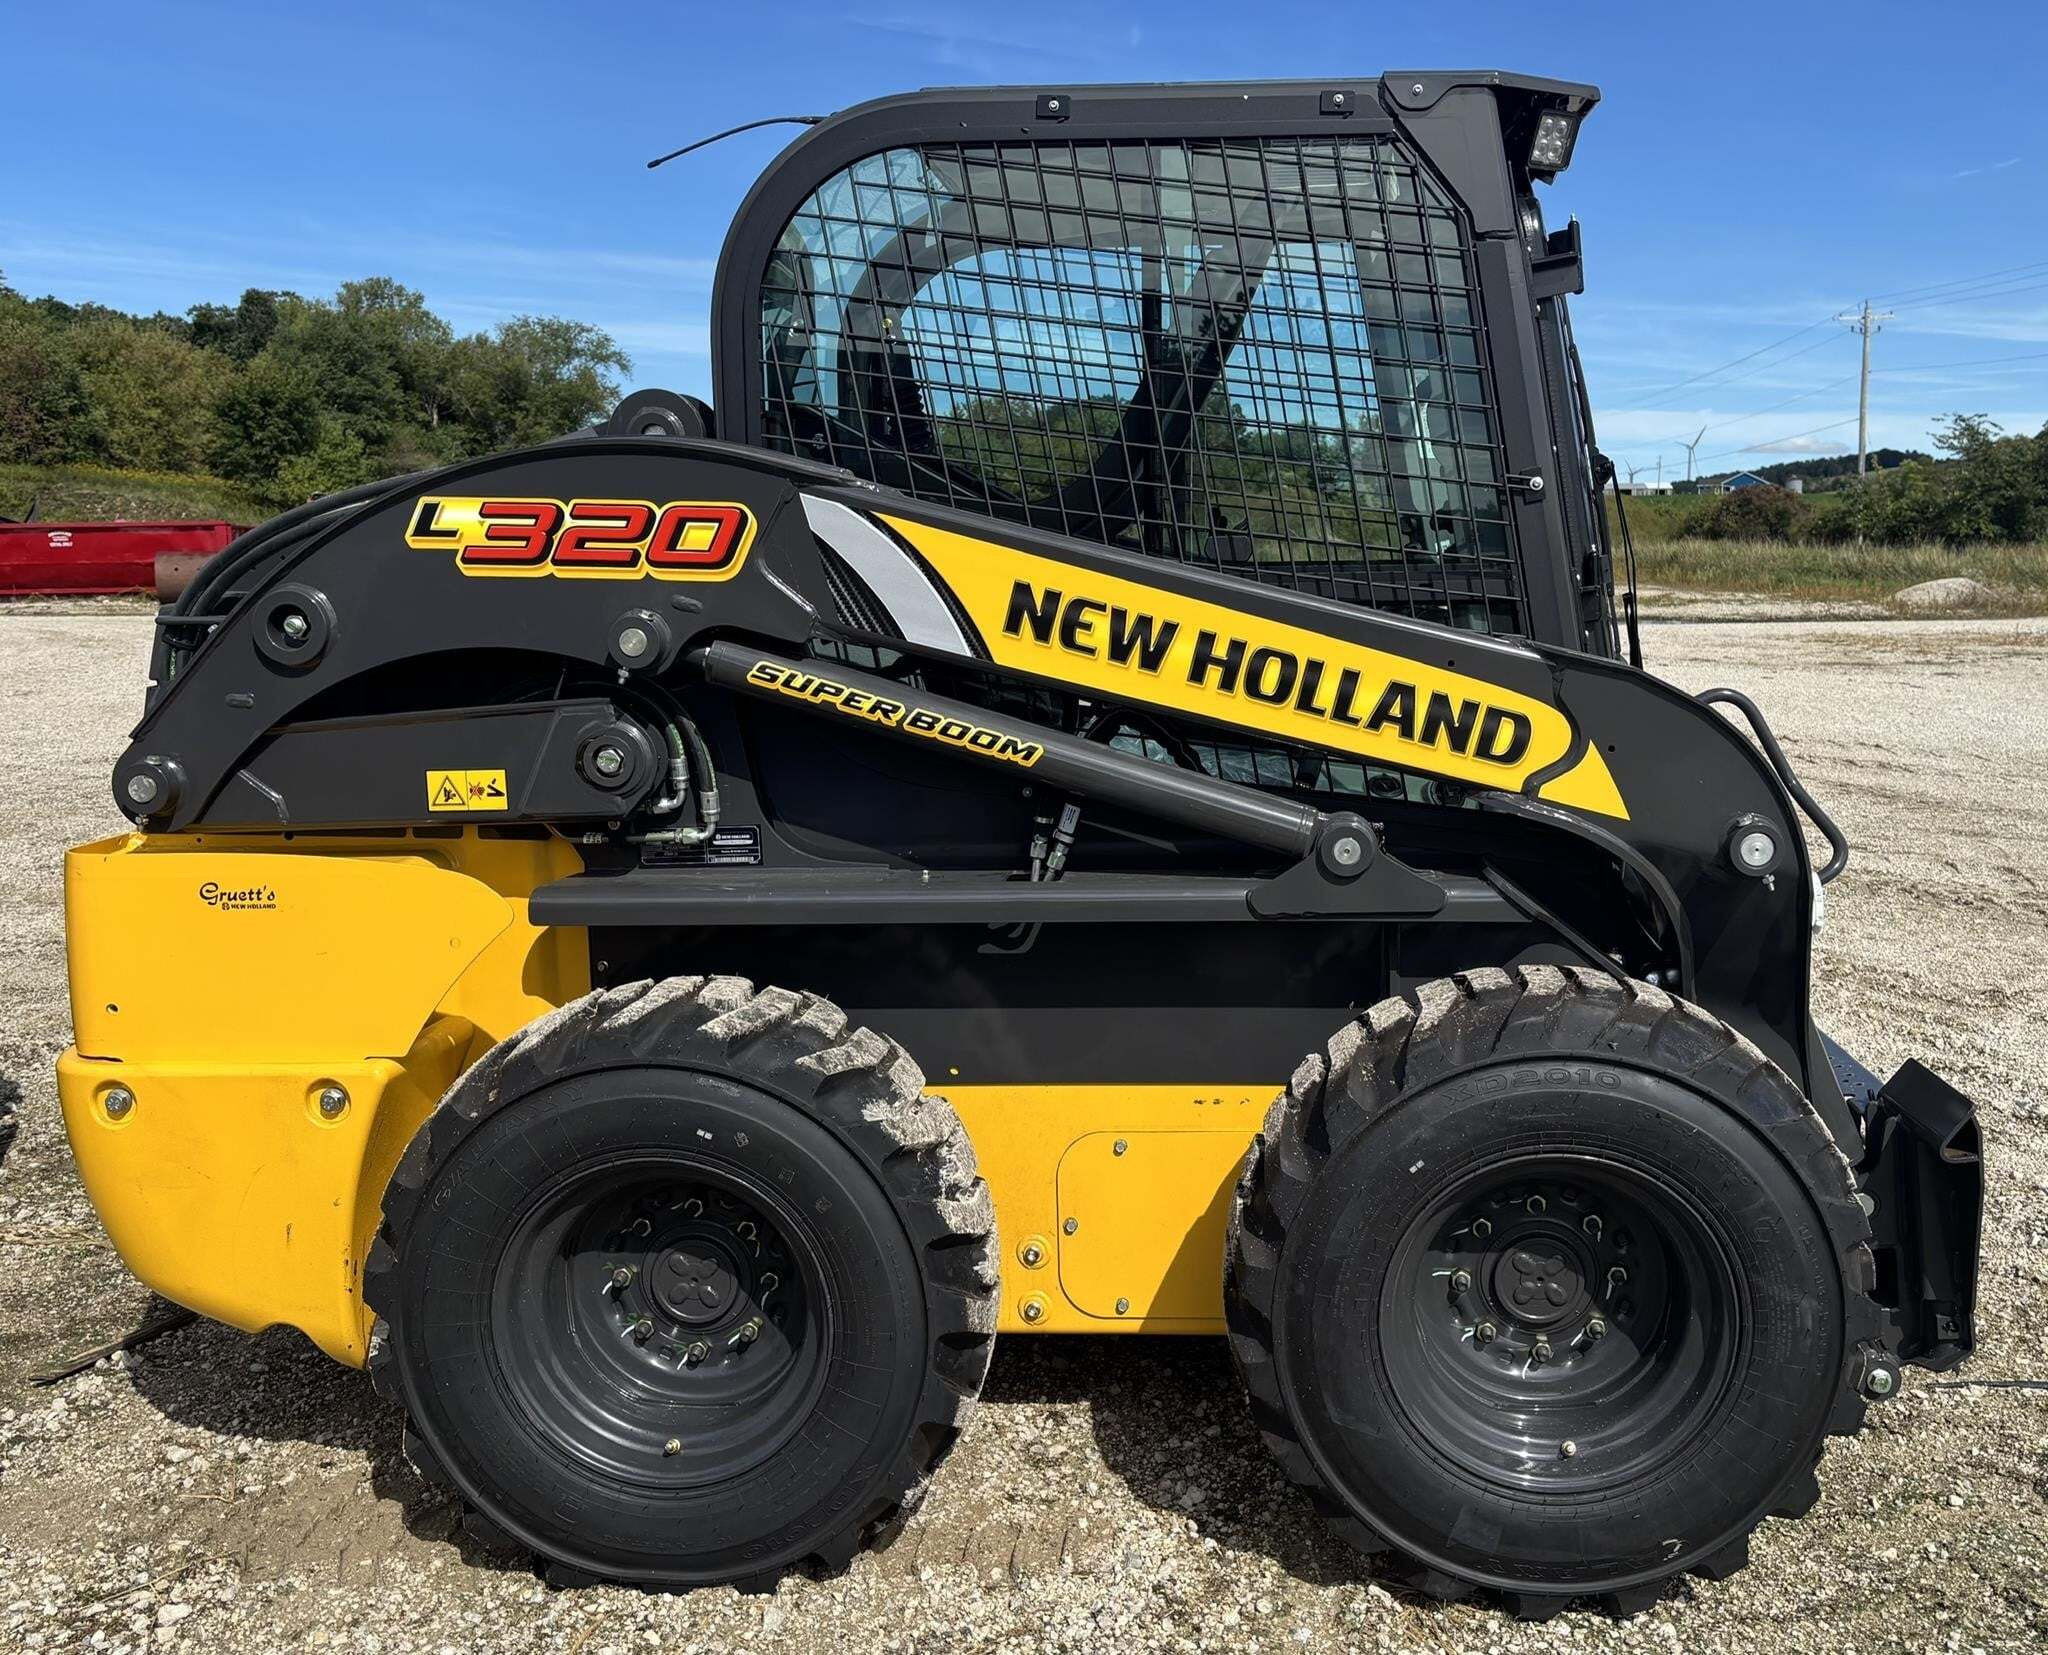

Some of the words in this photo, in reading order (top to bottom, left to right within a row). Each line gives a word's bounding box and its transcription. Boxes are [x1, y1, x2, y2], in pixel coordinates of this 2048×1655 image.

[409, 499, 751, 572] L320
[1002, 579, 1179, 673] NEW
[1187, 629, 1534, 767] HOLLAND
[748, 662, 903, 724] SUPER
[906, 709, 1042, 765] BOOM
[199, 882, 276, 906] Gruett's
[1443, 1067, 1622, 1106] XD2010
